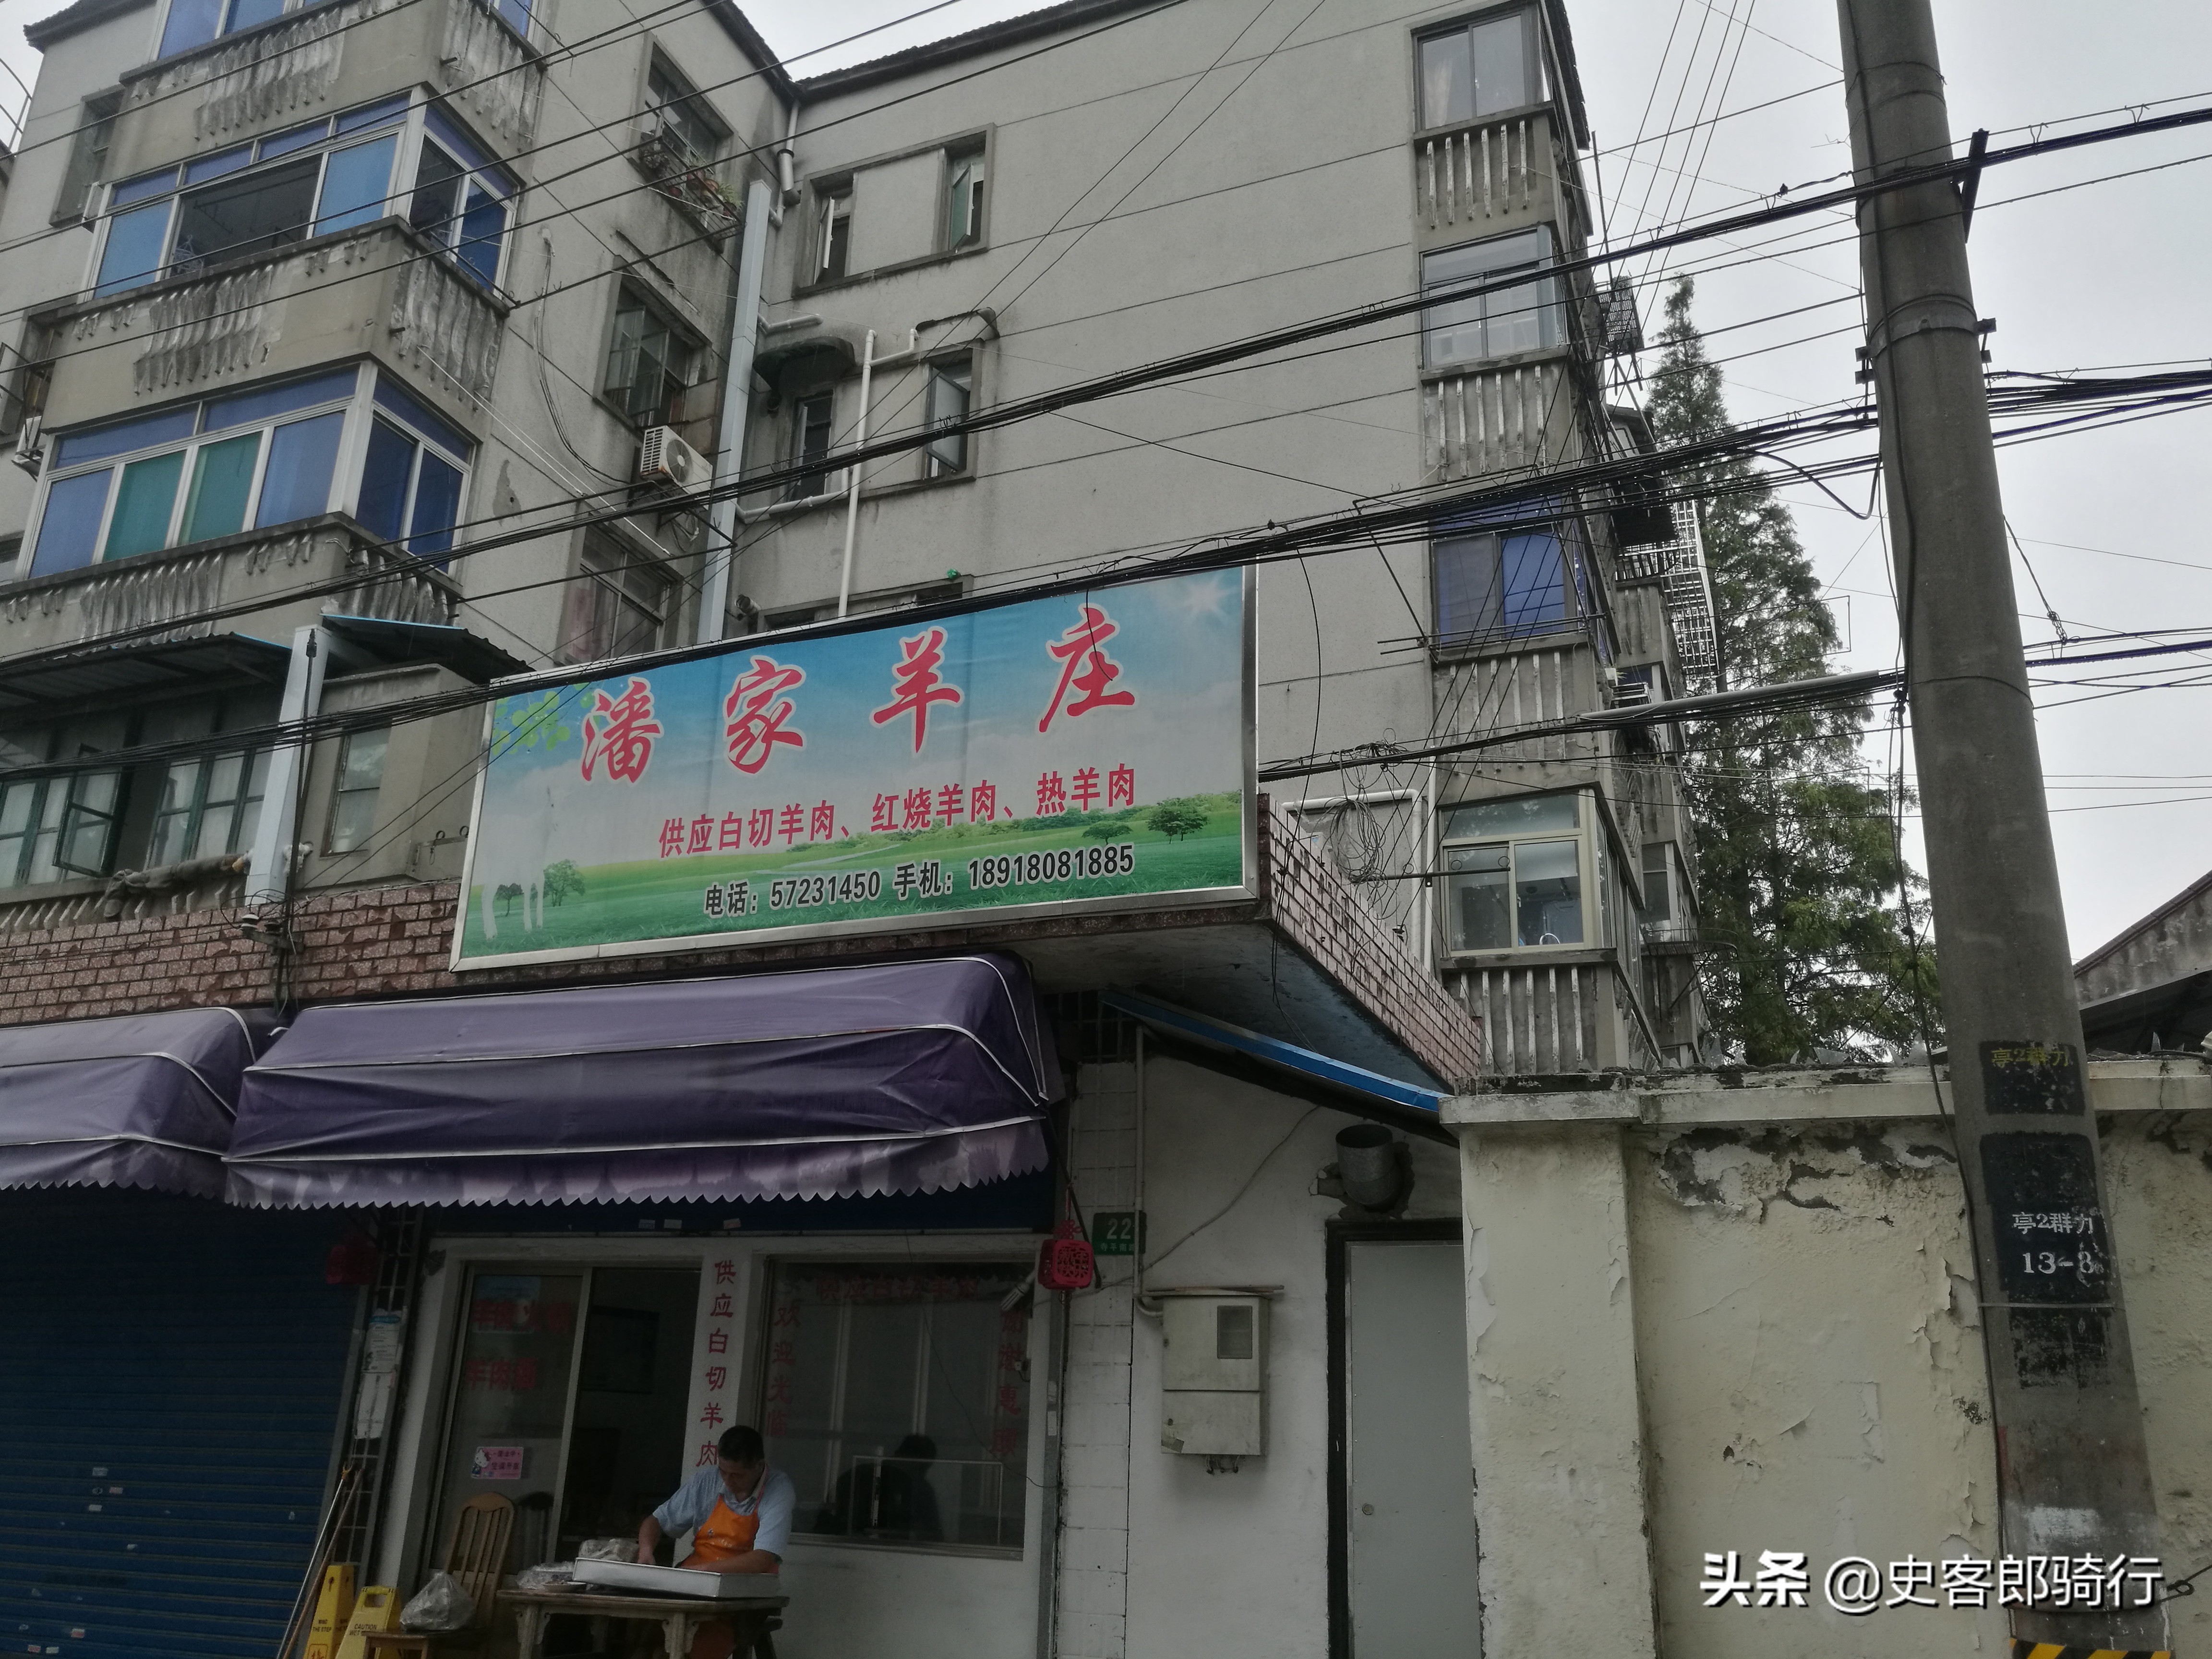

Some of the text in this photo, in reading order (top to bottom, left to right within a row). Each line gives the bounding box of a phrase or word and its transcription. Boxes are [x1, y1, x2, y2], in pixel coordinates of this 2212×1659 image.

[582, 607, 1135, 783] 潘家羊庄
[659, 764, 1134, 858] 供应白切羊肉、红烧羊肉、热羊肉
[1106, 1218, 1131, 1239] 22
[2012, 1211, 2093, 1234] 亭2群力
[696, 1260, 736, 1467] 供应白切羊肉
[768, 1305, 801, 1437] 欢迎光临
